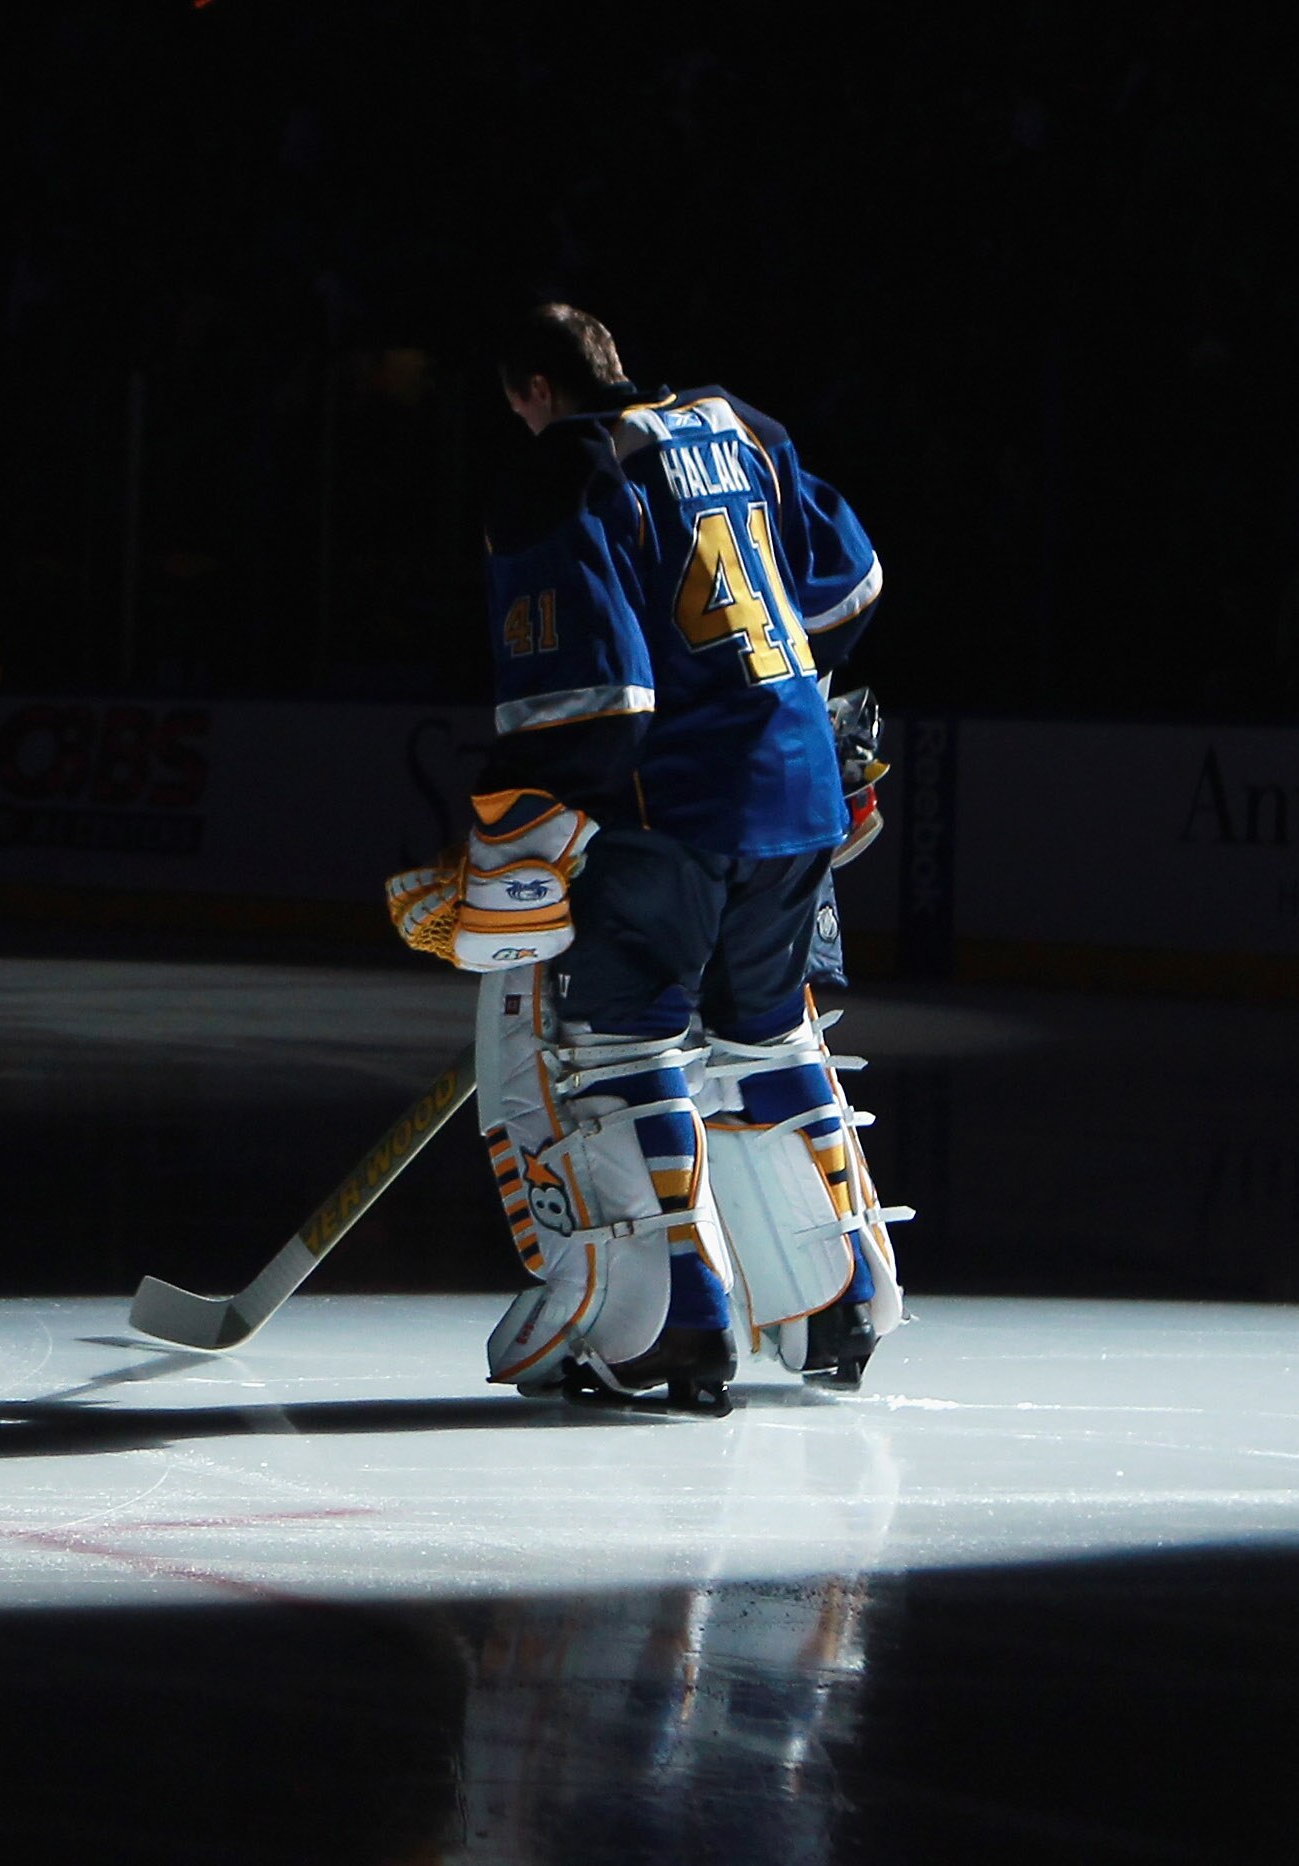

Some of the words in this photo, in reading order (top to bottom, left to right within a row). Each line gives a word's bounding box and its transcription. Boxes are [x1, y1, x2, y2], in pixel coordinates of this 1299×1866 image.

[659, 440, 751, 499] HALAK
[504, 588, 559, 658] 41
[671, 500, 818, 687] 41
[911, 719, 949, 915] Reebok
[1178, 742, 1299, 846] An
